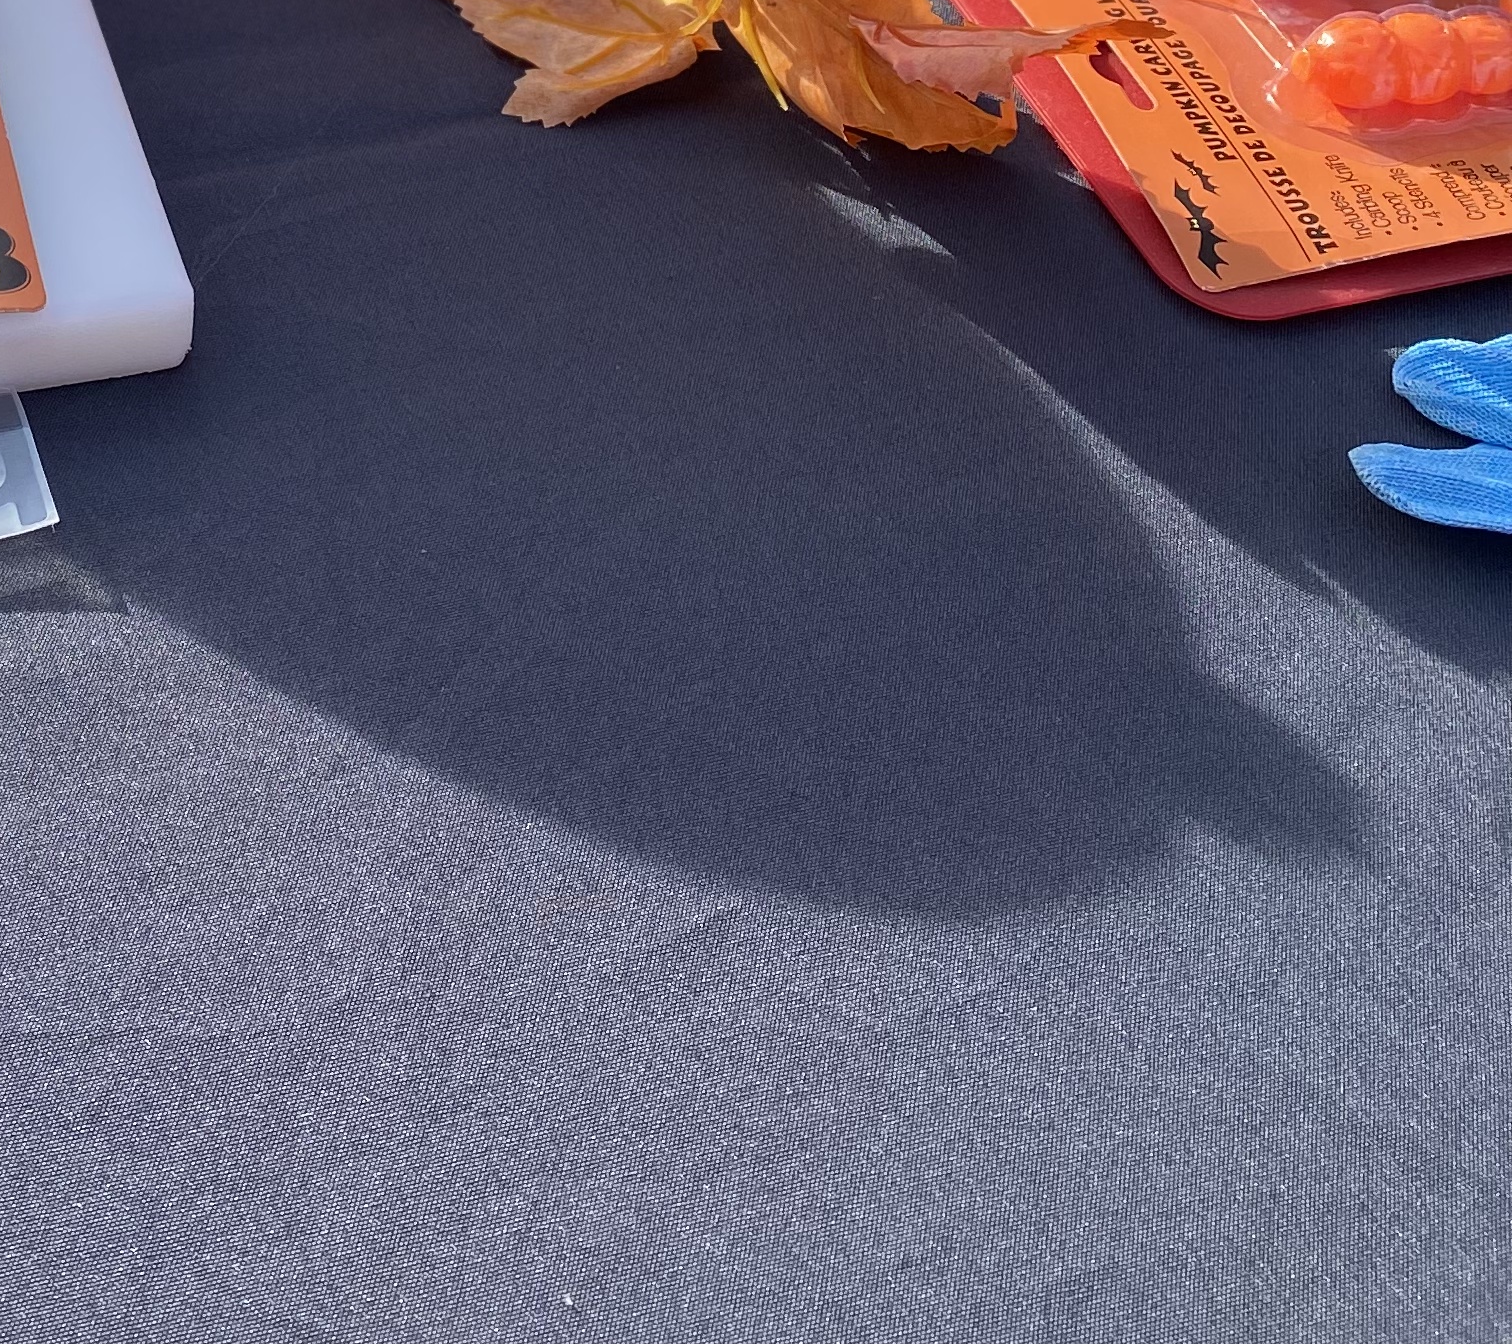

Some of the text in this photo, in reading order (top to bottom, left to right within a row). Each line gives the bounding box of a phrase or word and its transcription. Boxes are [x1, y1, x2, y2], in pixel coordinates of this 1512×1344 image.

[1164, 39, 1256, 135] DECOUPAGE
[1160, 81, 1239, 162] PUMPKIN
[1242, 139, 1277, 162] DE
[1325, 154, 1359, 183] Knife
[1263, 167, 1340, 255] TROUSSE
[1382, 191, 1417, 224] Scoop
[1389, 168, 1441, 219] 4 Stencils
[1463, 168, 1505, 210] Couteau
[1330, 190, 1373, 240] Includes:
